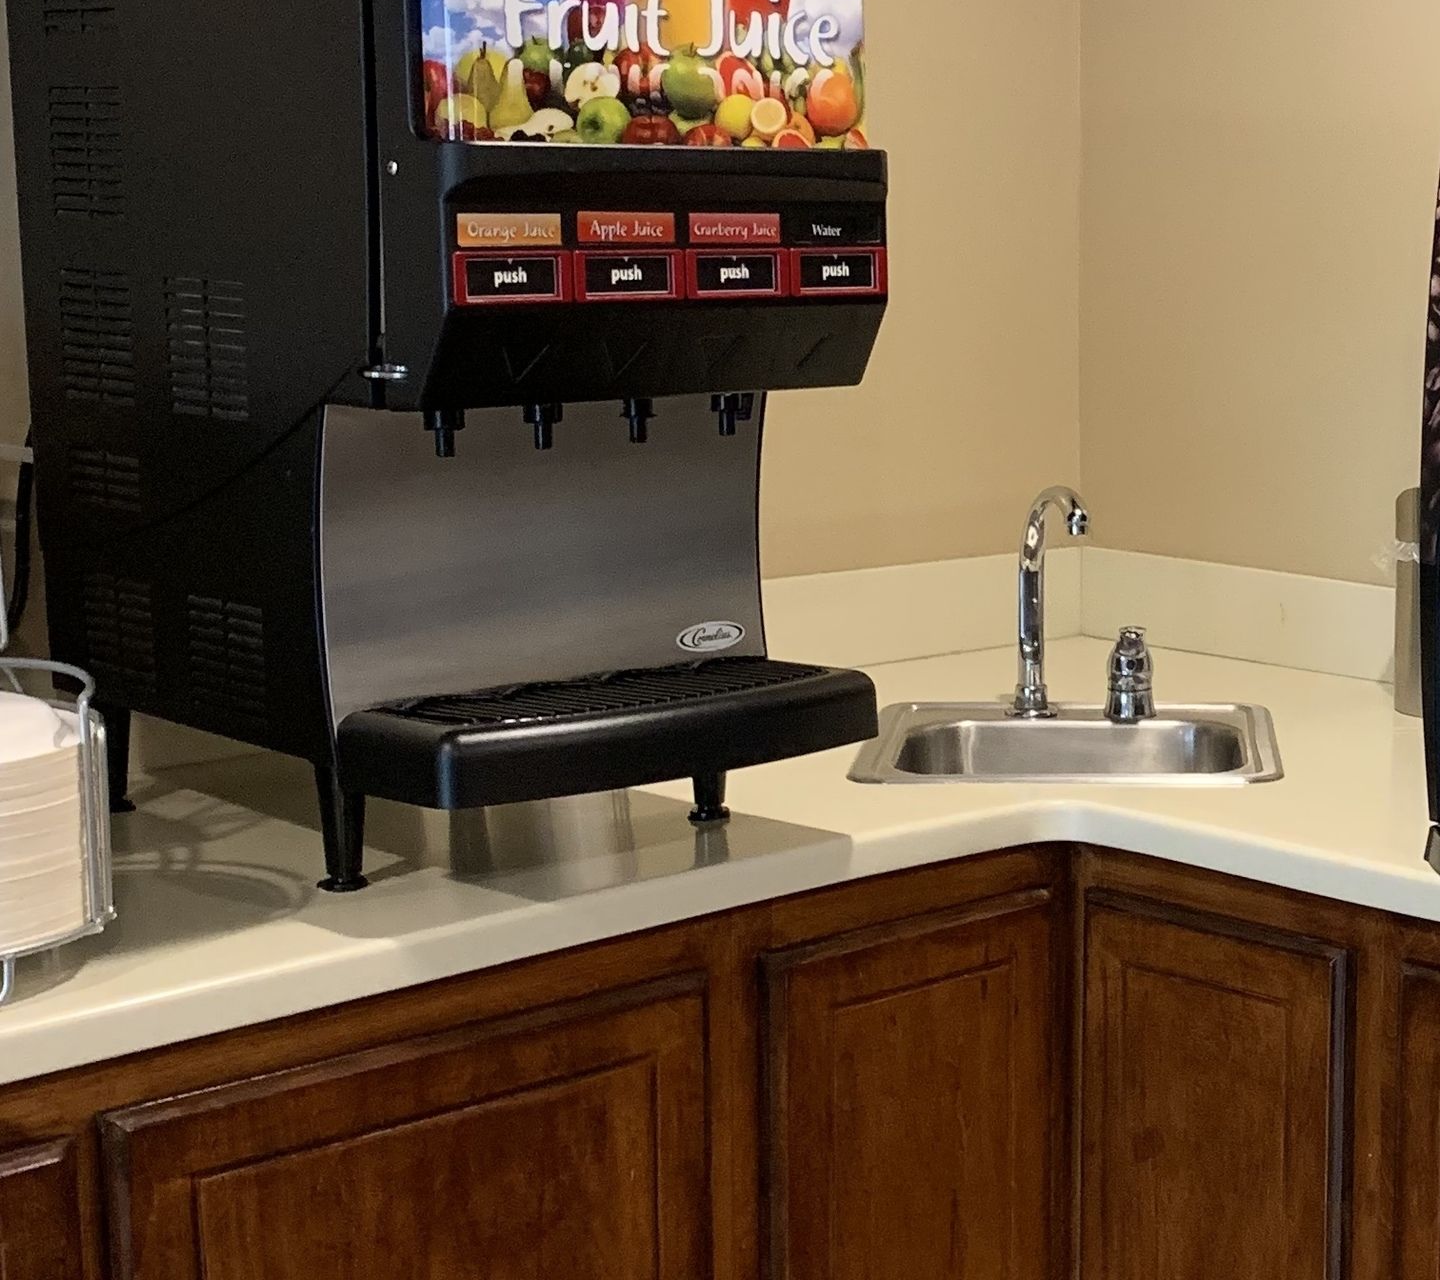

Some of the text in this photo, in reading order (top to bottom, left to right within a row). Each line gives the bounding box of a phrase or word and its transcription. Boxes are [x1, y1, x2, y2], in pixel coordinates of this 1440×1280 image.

[467, 221, 555, 242] Orange Juice
[590, 219, 664, 240] Apple Juice
[694, 223, 777, 239] Cranberry Juice
[811, 223, 842, 237] Water
[494, 266, 527, 288] push
[611, 264, 643, 285] push
[720, 263, 750, 283] push
[822, 261, 850, 281] push
